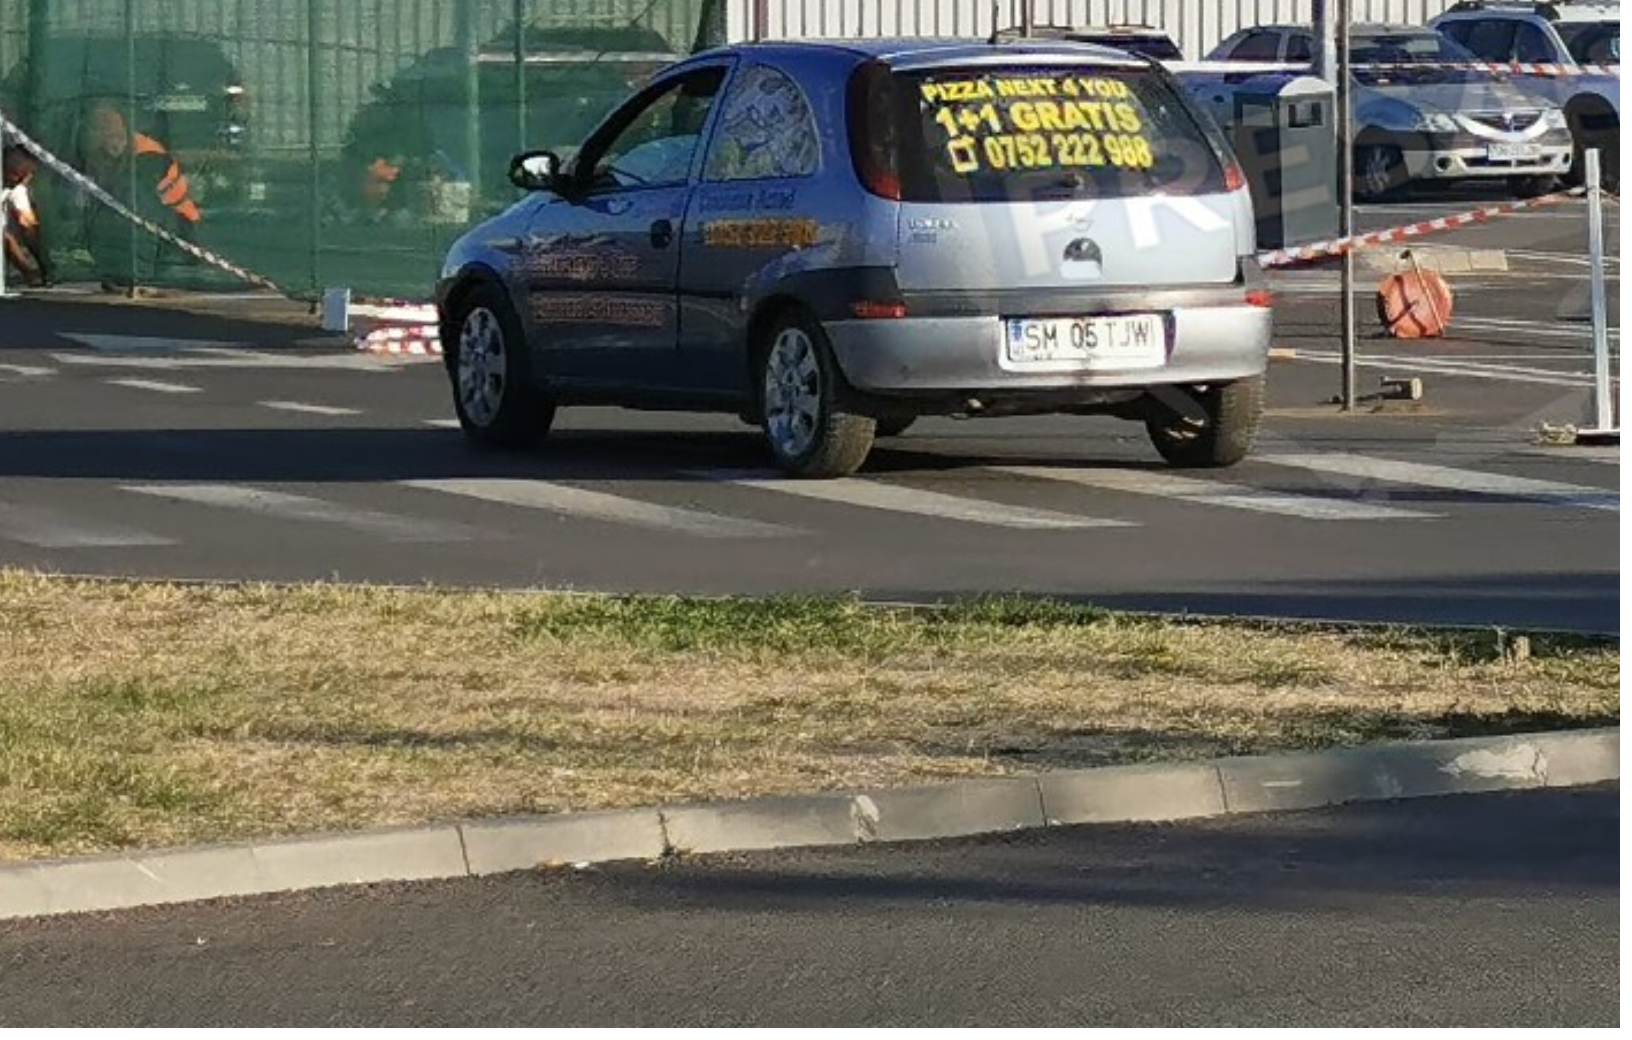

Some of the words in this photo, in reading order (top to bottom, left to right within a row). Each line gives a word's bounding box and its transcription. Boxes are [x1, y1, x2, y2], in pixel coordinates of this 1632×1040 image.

[920, 79, 994, 102] PIZZA
[995, 78, 1058, 97] NEXT
[1062, 78, 1079, 97] 4
[1079, 77, 1129, 98] YOU
[936, 102, 1002, 137] 1+1
[1010, 101, 1142, 134] GRATIS
[983, 134, 1053, 169] 0752
[1053, 133, 1105, 166] 222
[1104, 133, 1153, 169] 988
[1024, 322, 1058, 349] SM
[1070, 322, 1098, 349] 05
[1105, 321, 1150, 348] TJW
